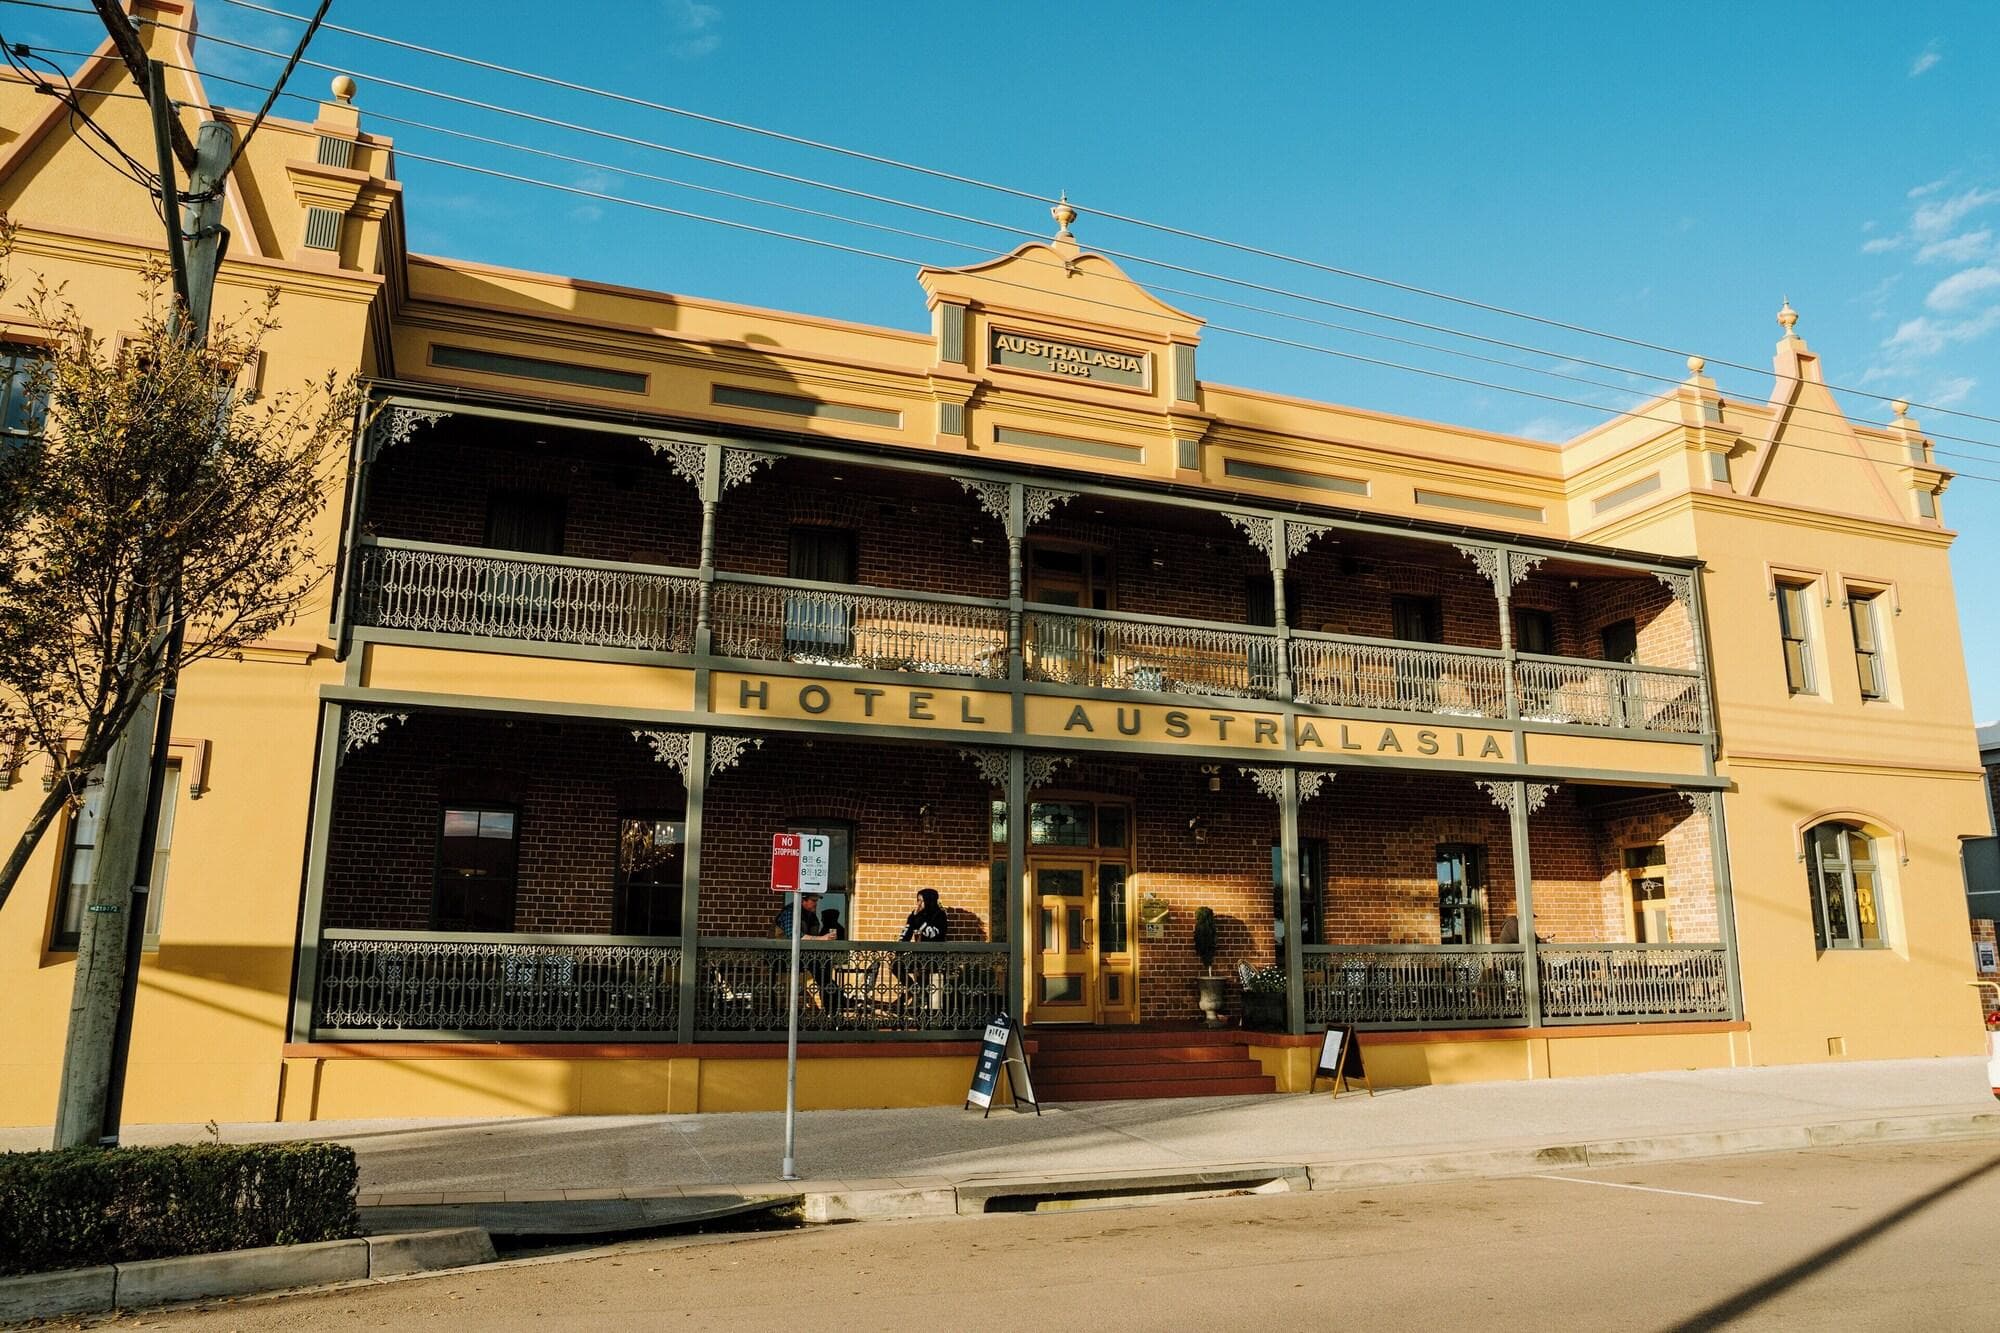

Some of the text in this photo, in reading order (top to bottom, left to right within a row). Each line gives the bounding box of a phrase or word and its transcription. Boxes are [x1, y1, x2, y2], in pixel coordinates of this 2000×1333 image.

[996, 335, 1143, 373] AUSTRALASIA
[1048, 361, 1091, 377] 1904
[740, 680, 1504, 760] HOTEL AUSTRALASIA
[781, 837, 793, 847] NO
[808, 838, 823, 852] 1P
[774, 848, 800, 857] STOPPING
